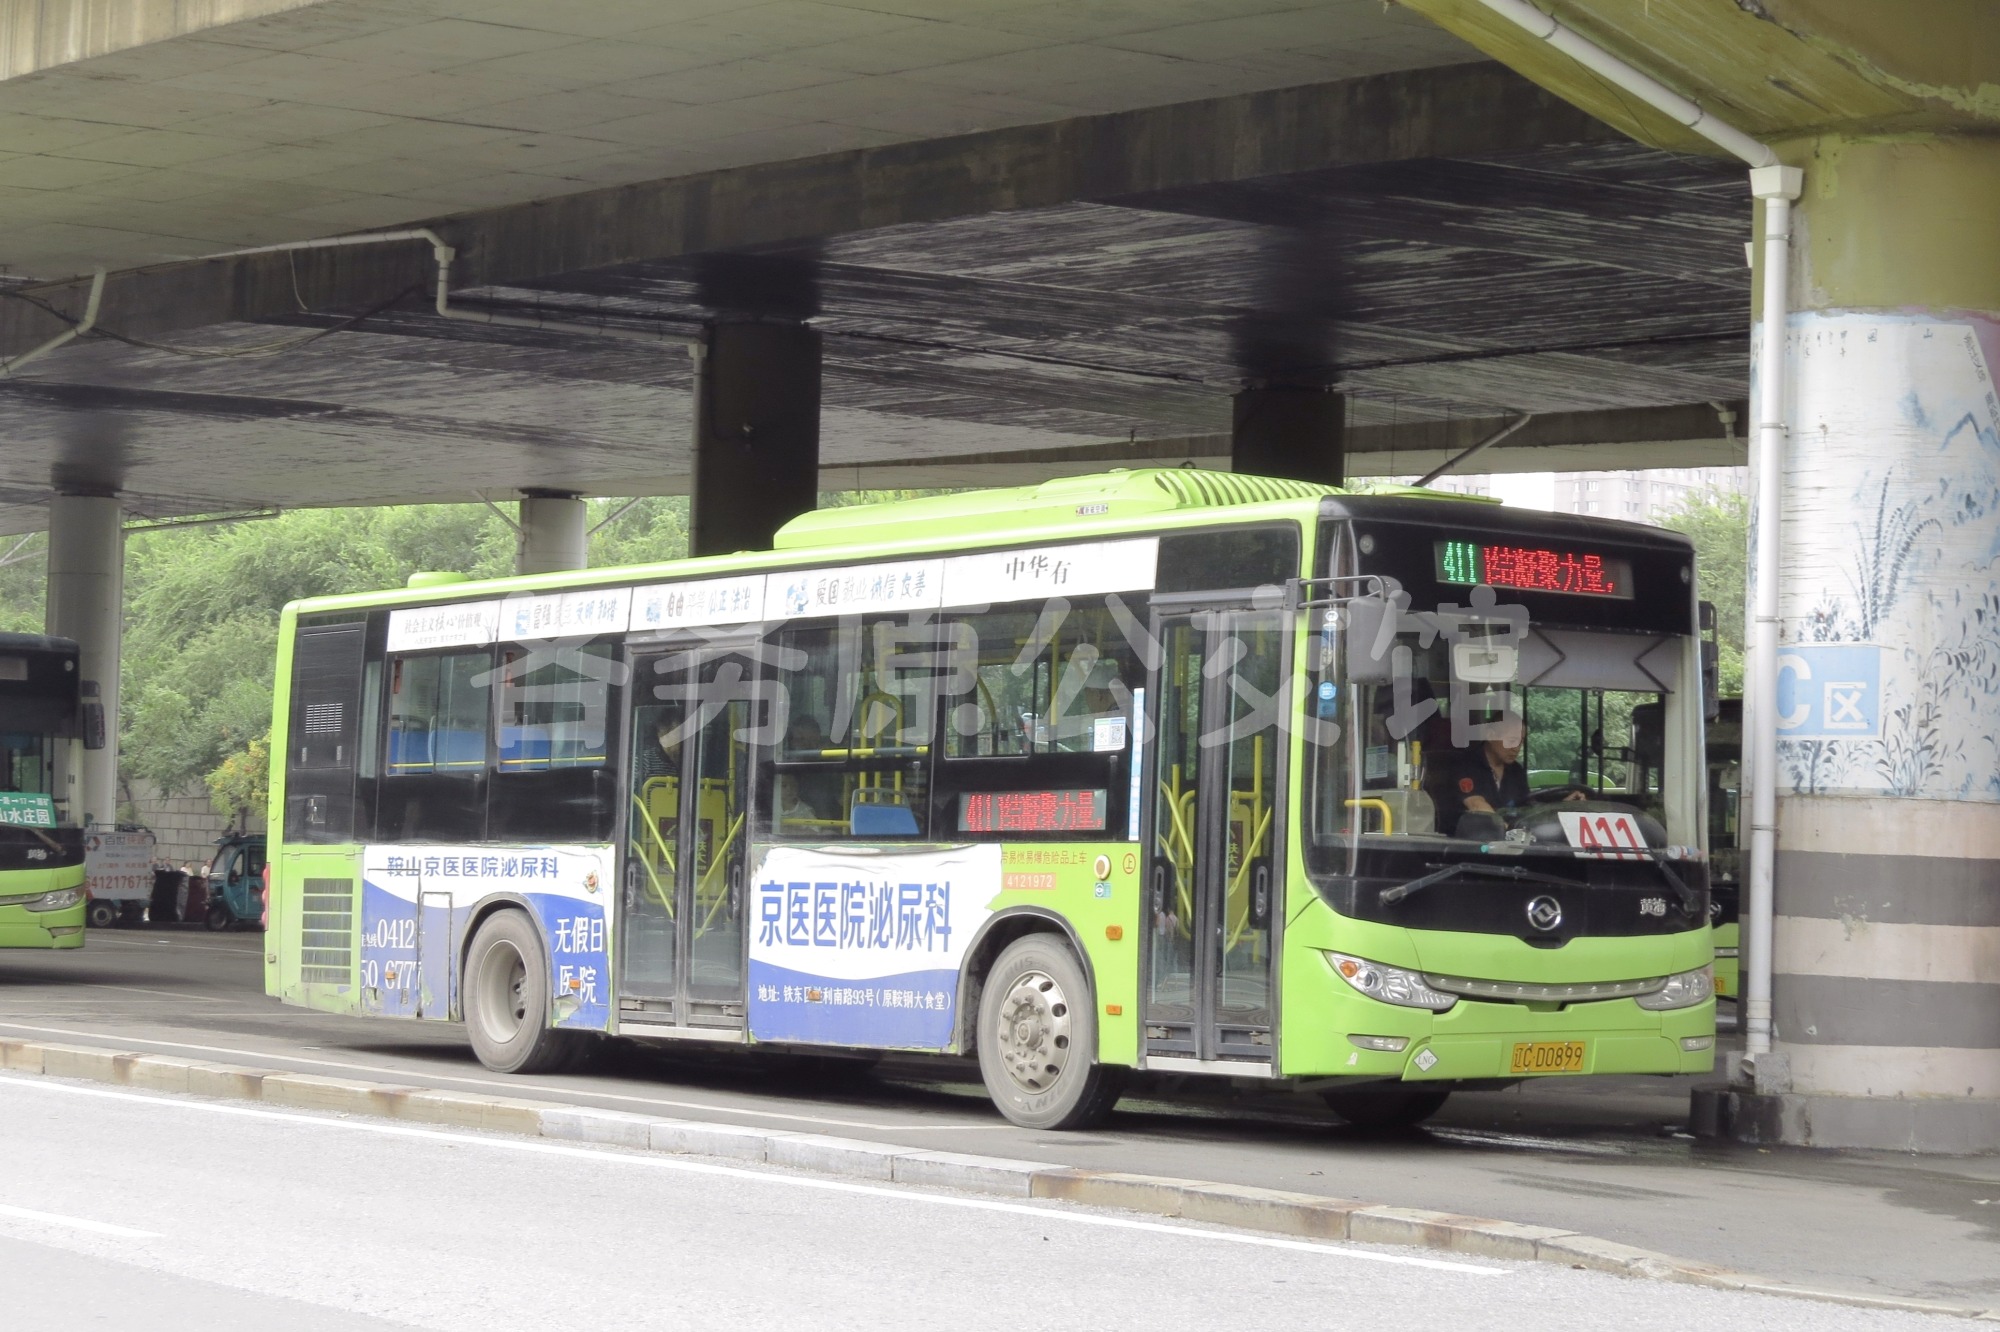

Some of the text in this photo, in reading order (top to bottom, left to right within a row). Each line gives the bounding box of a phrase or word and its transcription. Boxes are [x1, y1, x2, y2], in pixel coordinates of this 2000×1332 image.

[1444, 541, 1476, 583] 411
[1578, 815, 1653, 860] 411
[387, 856, 559, 879] 鞍山京医医院泌尿科
[1007, 874, 1053, 888] 4121972
[554, 916, 604, 954] 无假日
[758, 879, 952, 953] 京医医院泌尿科
[559, 965, 598, 1004] 医院
[1418, 1054, 1434, 1066] LNG
